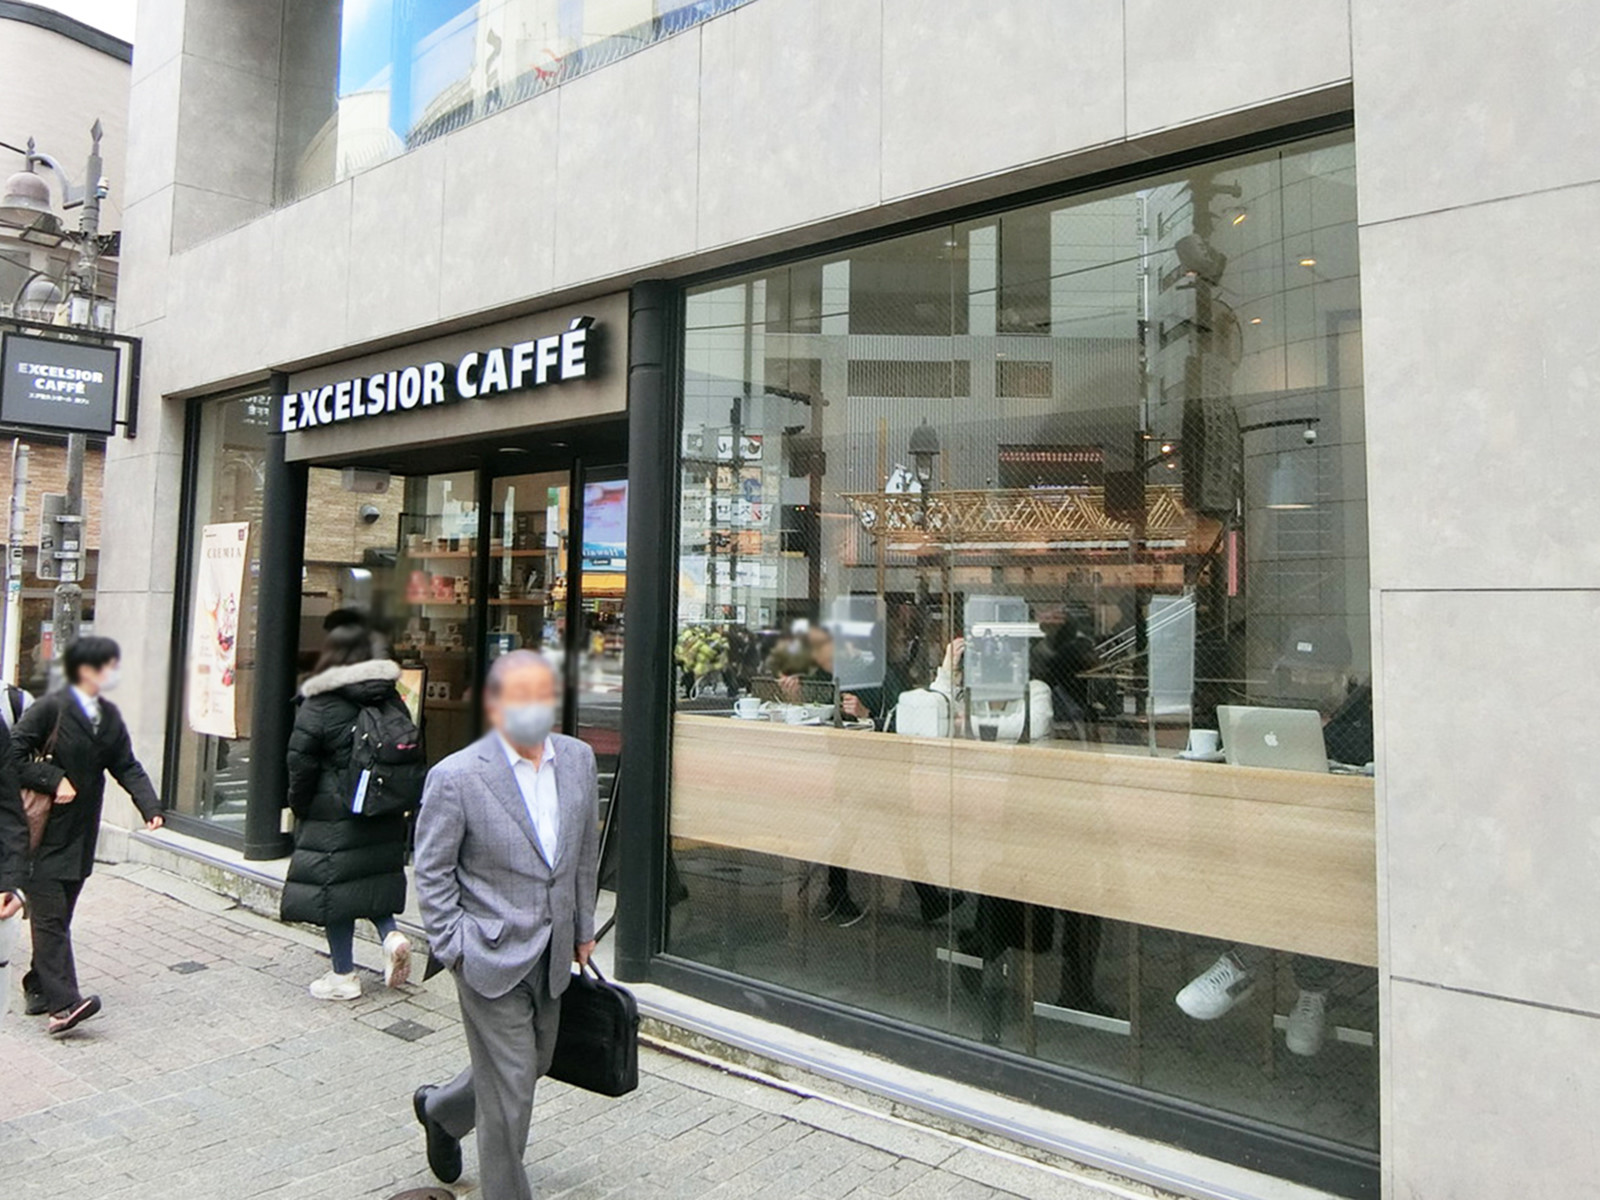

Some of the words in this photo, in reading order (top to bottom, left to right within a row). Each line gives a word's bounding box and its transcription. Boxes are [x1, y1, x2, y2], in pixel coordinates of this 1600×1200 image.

[18, 362, 103, 383] EXCELSIOR
[281, 361, 446, 433] EXCELSIOR
[456, 317, 588, 399] CAFFÉ
[33, 378, 86, 394] CAFFÉ
